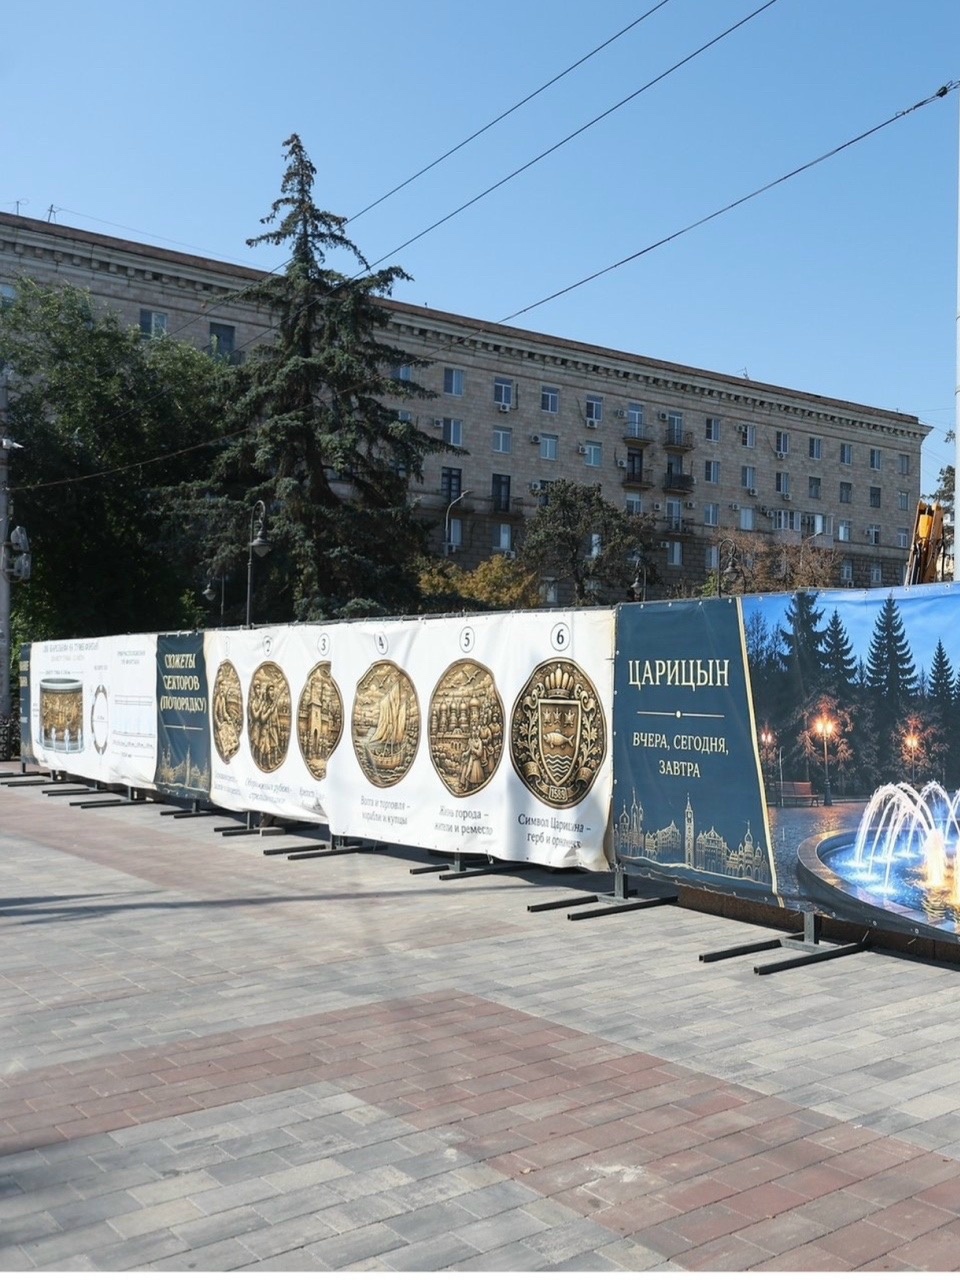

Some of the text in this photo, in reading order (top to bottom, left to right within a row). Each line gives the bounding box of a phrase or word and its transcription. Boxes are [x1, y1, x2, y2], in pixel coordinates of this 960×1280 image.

[321, 638, 326, 651] 3
[464, 633, 471, 647] 5
[556, 630, 564, 645] 6
[164, 653, 197, 669] СЮЖЕТЫ
[163, 675, 200, 691] СЕКТОРОВ
[629, 660, 729, 691] ЦАРИЦЫН
[633, 732, 728, 755] ВЧЕРА, СЕГОДНЯ,
[659, 760, 700, 777] ЗАВТРА
[455, 809, 482, 820] города
[518, 813, 549, 828] Символ
[527, 831, 545, 845] герб
